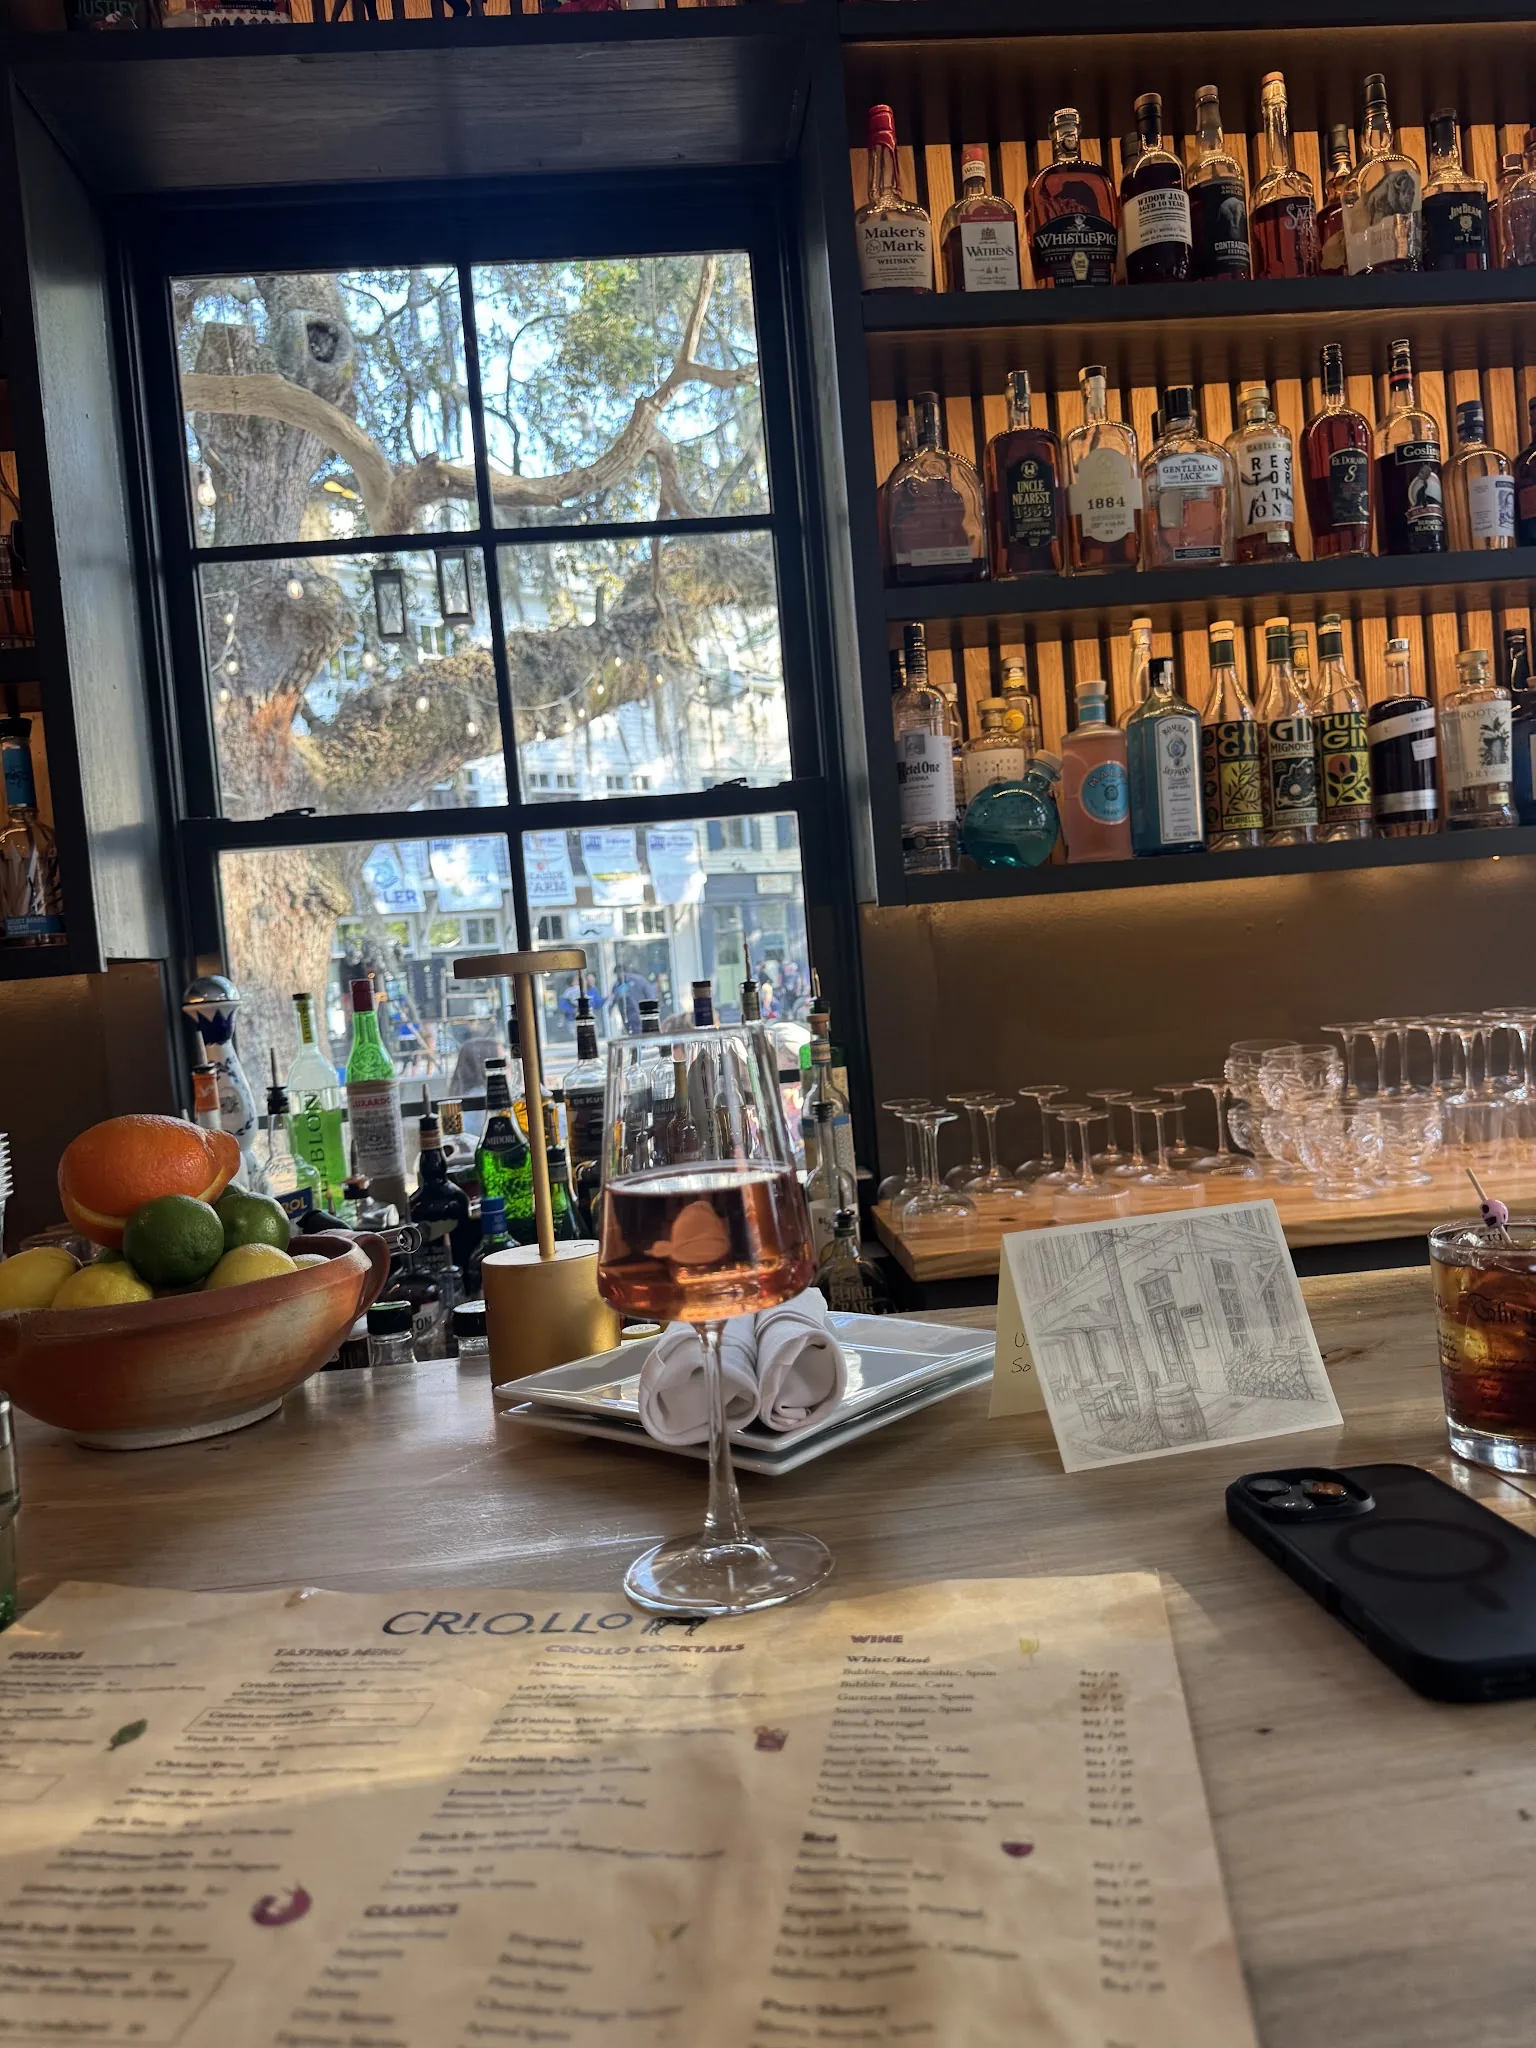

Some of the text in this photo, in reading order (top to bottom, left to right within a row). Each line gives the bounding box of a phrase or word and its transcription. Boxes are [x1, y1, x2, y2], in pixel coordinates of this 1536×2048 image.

[1137, 192, 1186, 206] WIDOW JANE
[1139, 202, 1156, 212] AGED
[1168, 200, 1186, 209] YEARS
[1449, 202, 1483, 220] JIM BEAM
[865, 226, 926, 240] Maker's
[882, 240, 926, 252] Mark
[1036, 231, 1117, 249] WHISTLEPIG
[965, 245, 1014, 257] WATHEN'S
[1162, 464, 1219, 474] GENTLEMAN
[1344, 464, 1356, 483] 8
[1180, 472, 1203, 481] JACK
[1017, 480, 1045, 493] UNCLE
[1012, 492, 1050, 506] NEAREST
[1087, 496, 1126, 510] 1884
[1161, 723, 1190, 736] BOMBAY
[1320, 714, 1368, 732] TULS
[1271, 741, 1313, 754] MIGNONE
[921, 760, 941, 774] One
[486, 1135, 516, 1145] MIDORI
[283, 1196, 308, 1217] ROL
[851, 1634, 904, 1644] WINE
[274, 1648, 407, 1658] TASTING MENU
[545, 1643, 745, 1656] CRIOLLO COCKTAILS
[846, 1655, 932, 1664] White/Rosé
[842, 1668, 889, 1677] Bubbles,
[965, 1669, 997, 1678] Spain
[840, 1680, 886, 1689] Bubbles
[940, 1693, 974, 1703] Spain
[939, 1705, 972, 1715] Spain
